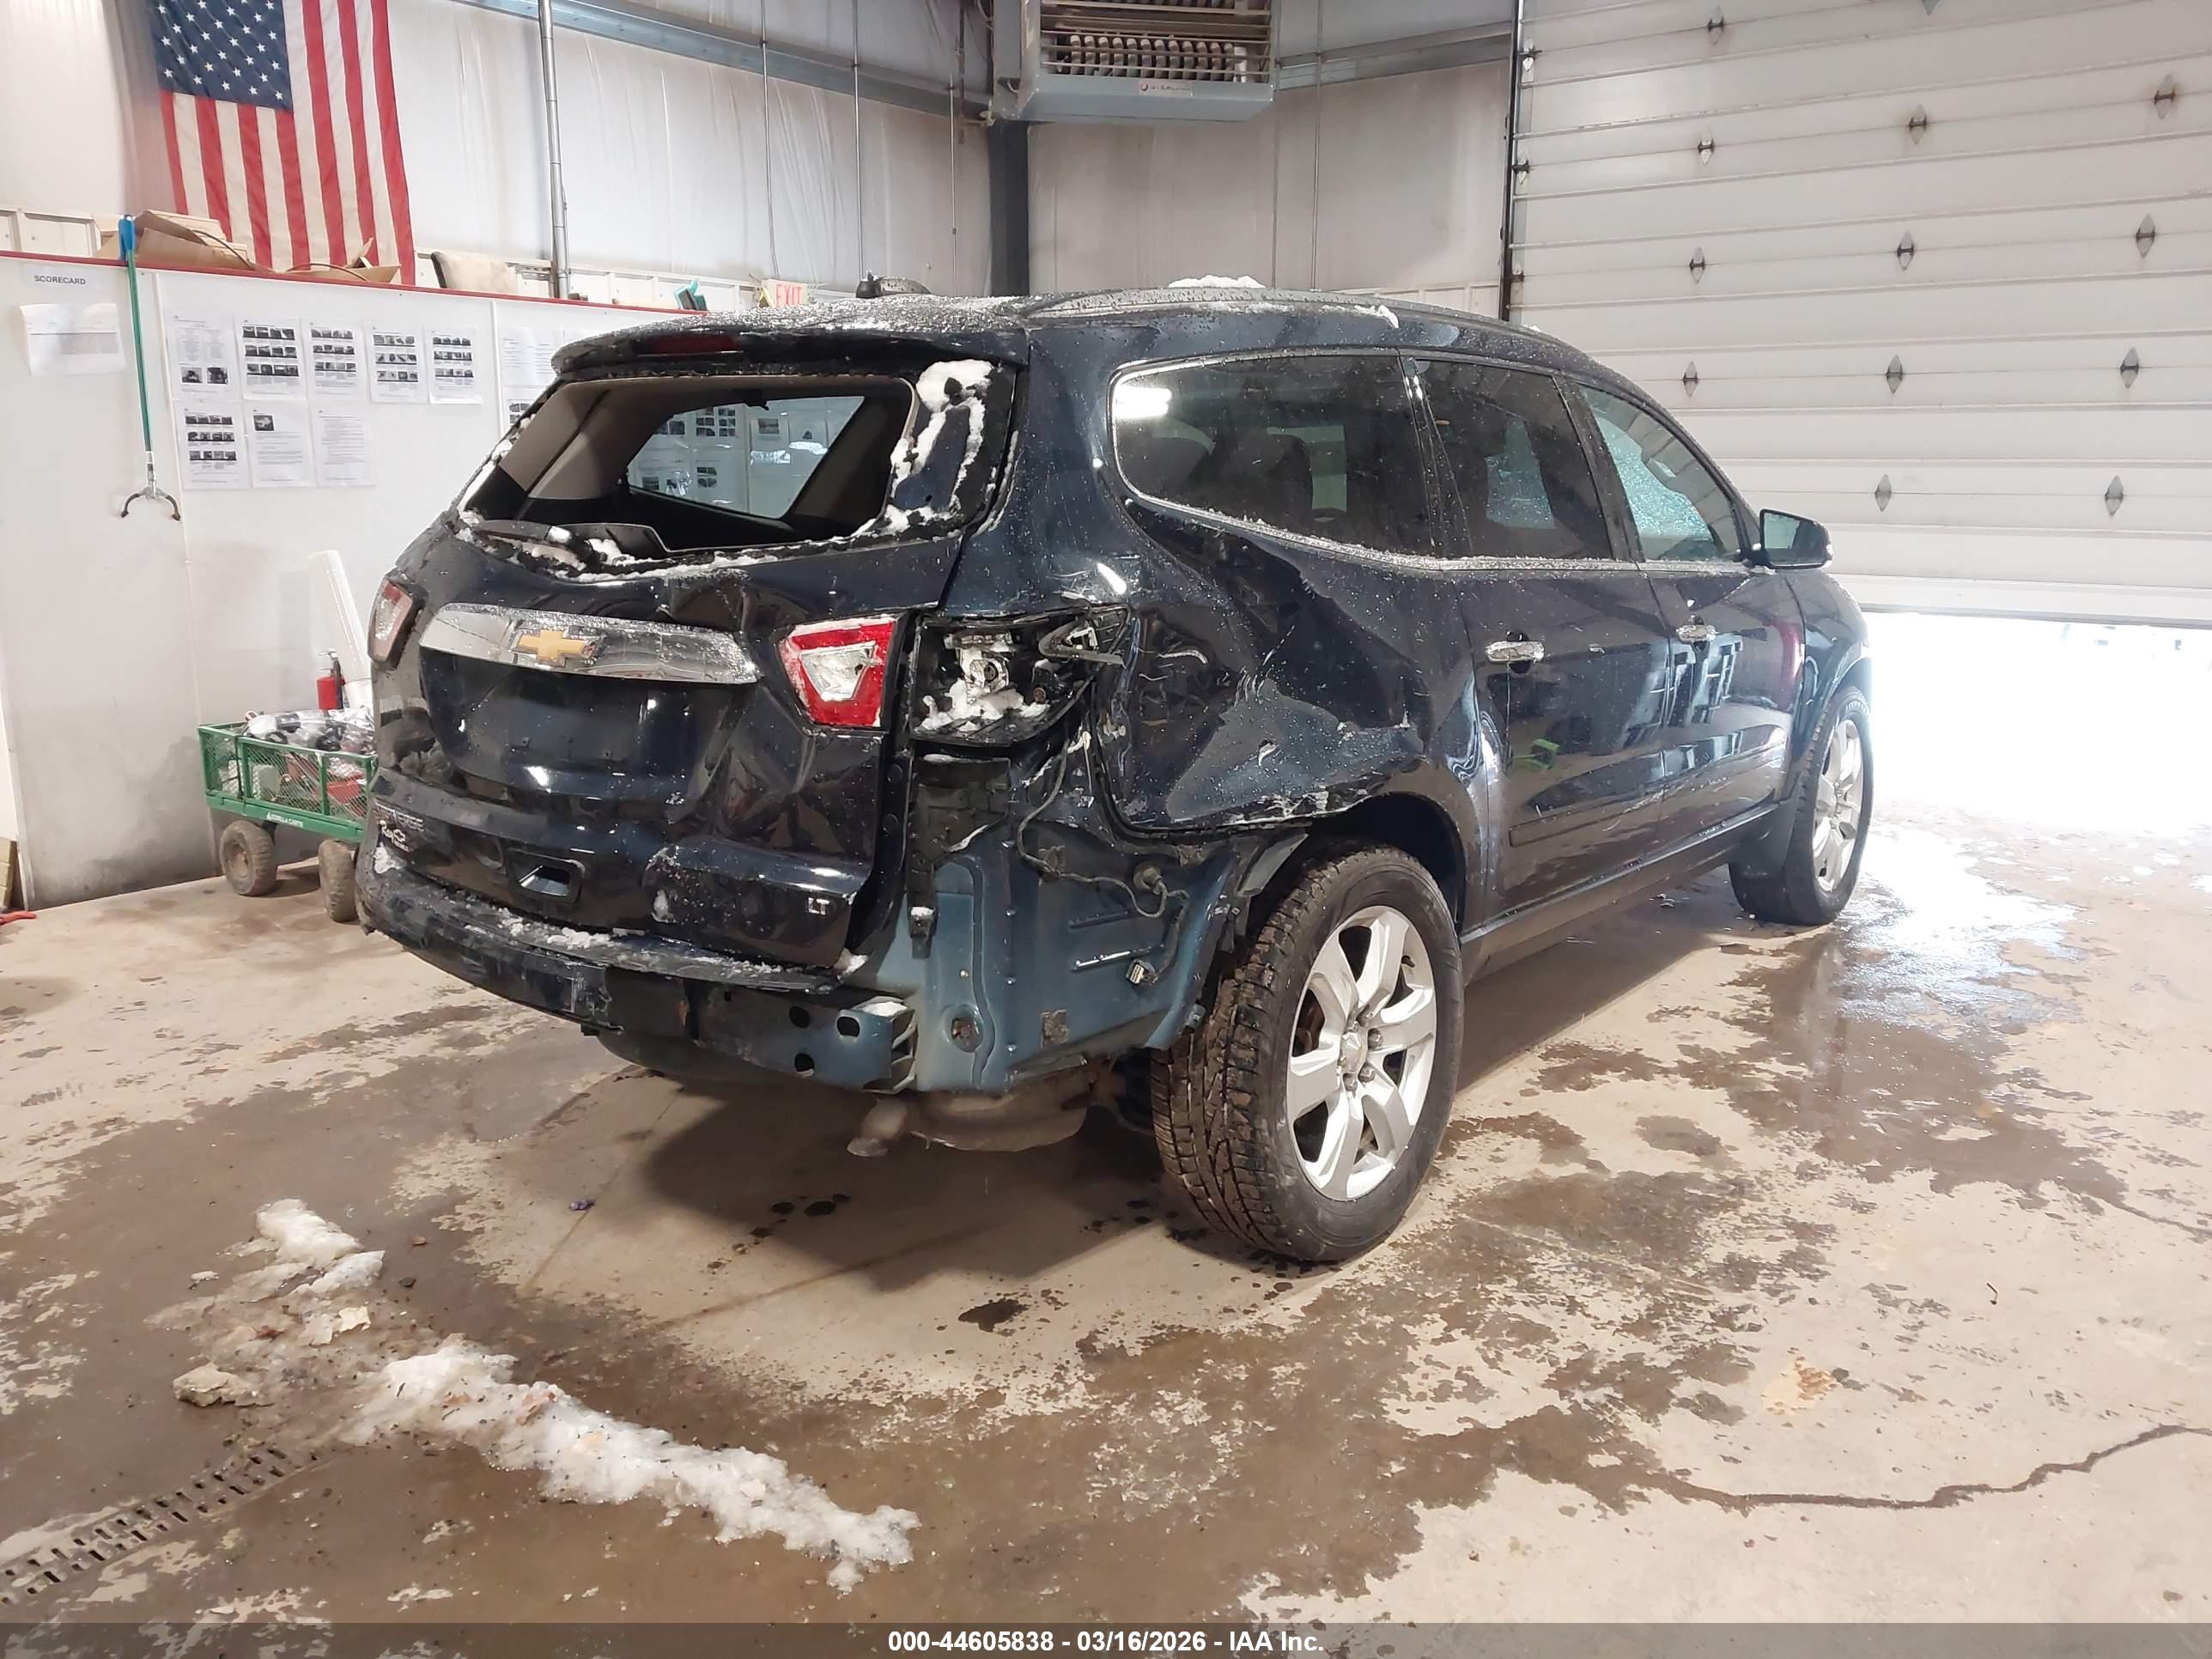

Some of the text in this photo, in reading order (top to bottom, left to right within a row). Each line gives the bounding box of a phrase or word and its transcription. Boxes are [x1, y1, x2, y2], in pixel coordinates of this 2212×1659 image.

[33, 274, 86, 285] SCORECARD
[775, 283, 803, 307] EXIT
[808, 896, 830, 916] LT
